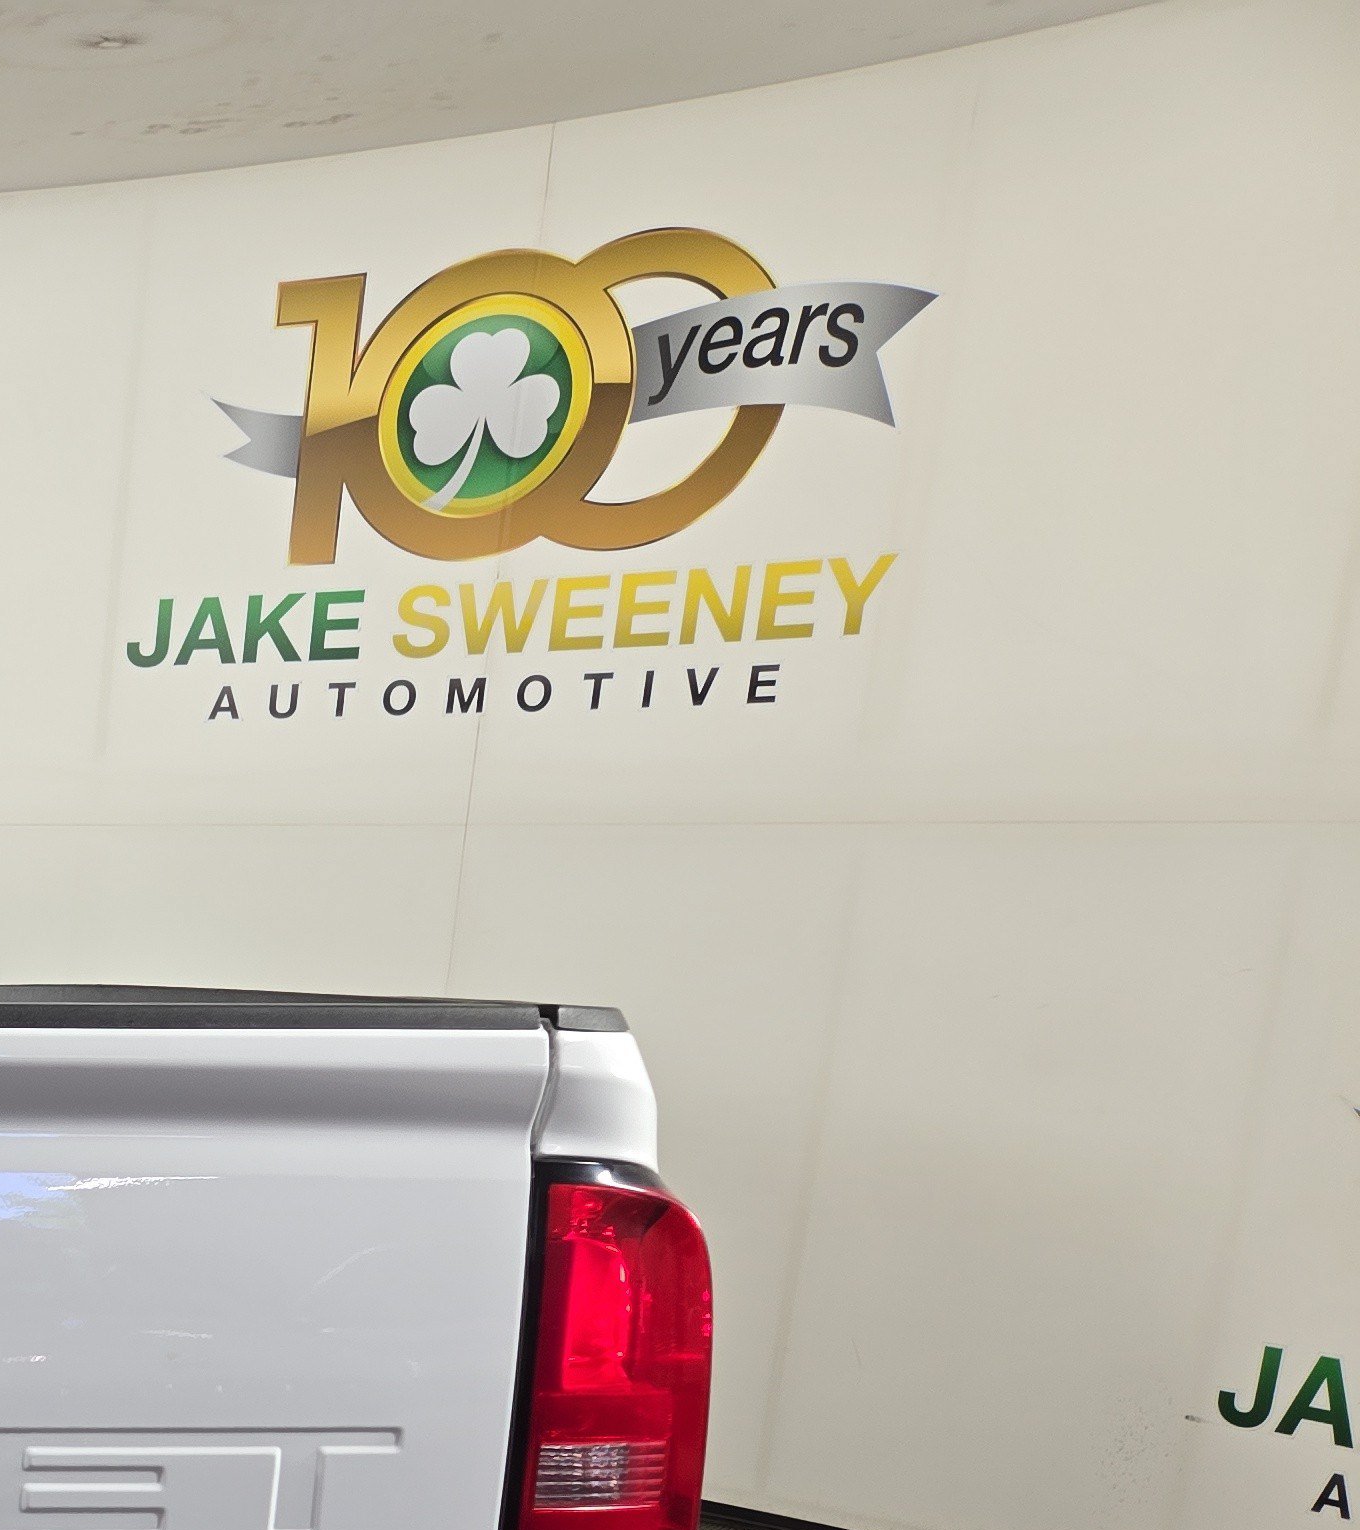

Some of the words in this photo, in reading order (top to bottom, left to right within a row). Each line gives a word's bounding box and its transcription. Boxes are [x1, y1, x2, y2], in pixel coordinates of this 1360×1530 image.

[647, 301, 865, 405] years
[126, 589, 366, 668] JAKE
[392, 553, 898, 660] SWEENEY
[207, 663, 782, 722] AUTOMOTIVE
